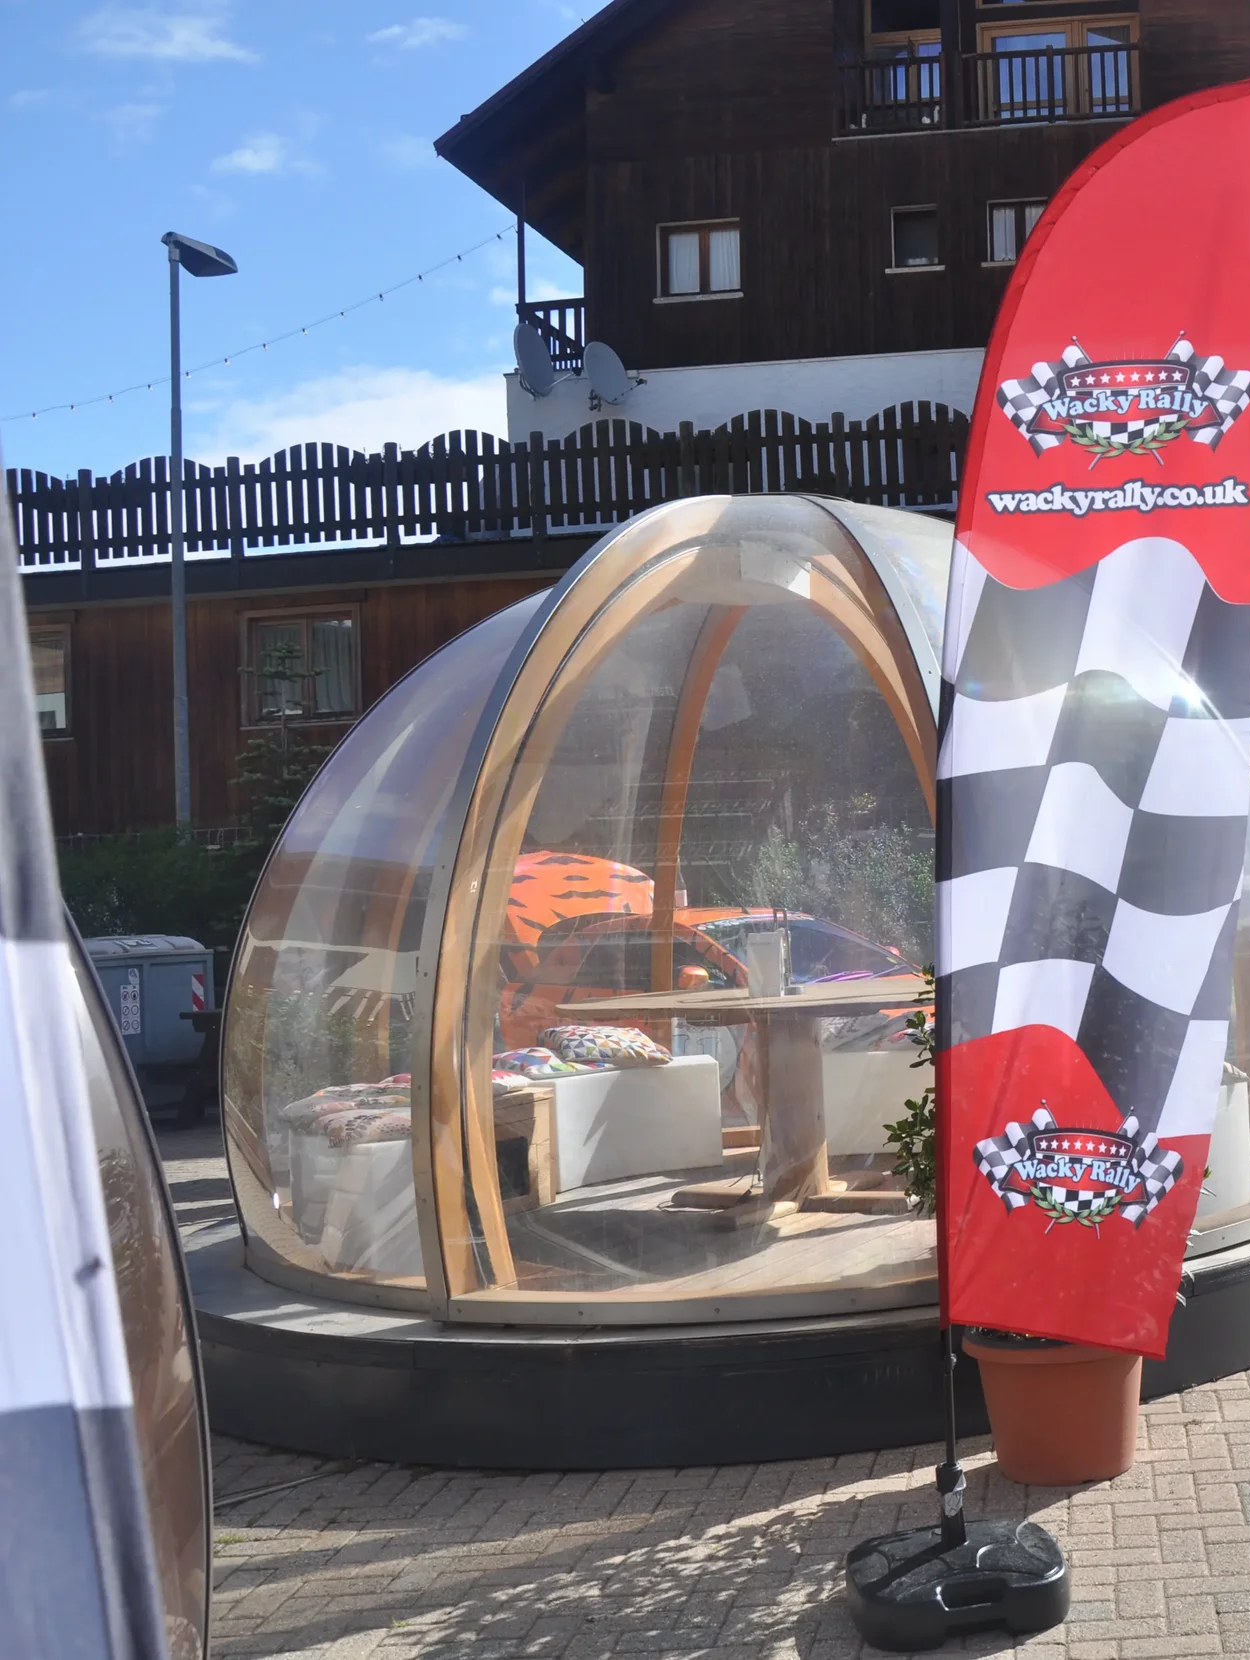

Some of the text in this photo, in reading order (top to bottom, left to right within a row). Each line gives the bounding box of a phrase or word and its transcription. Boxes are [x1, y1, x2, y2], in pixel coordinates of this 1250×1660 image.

[1042, 388, 1207, 421] Wacky Rally
[987, 478, 1250, 516] wackyrally.co.uk
[1014, 1157, 1141, 1193] Wacky Rally
